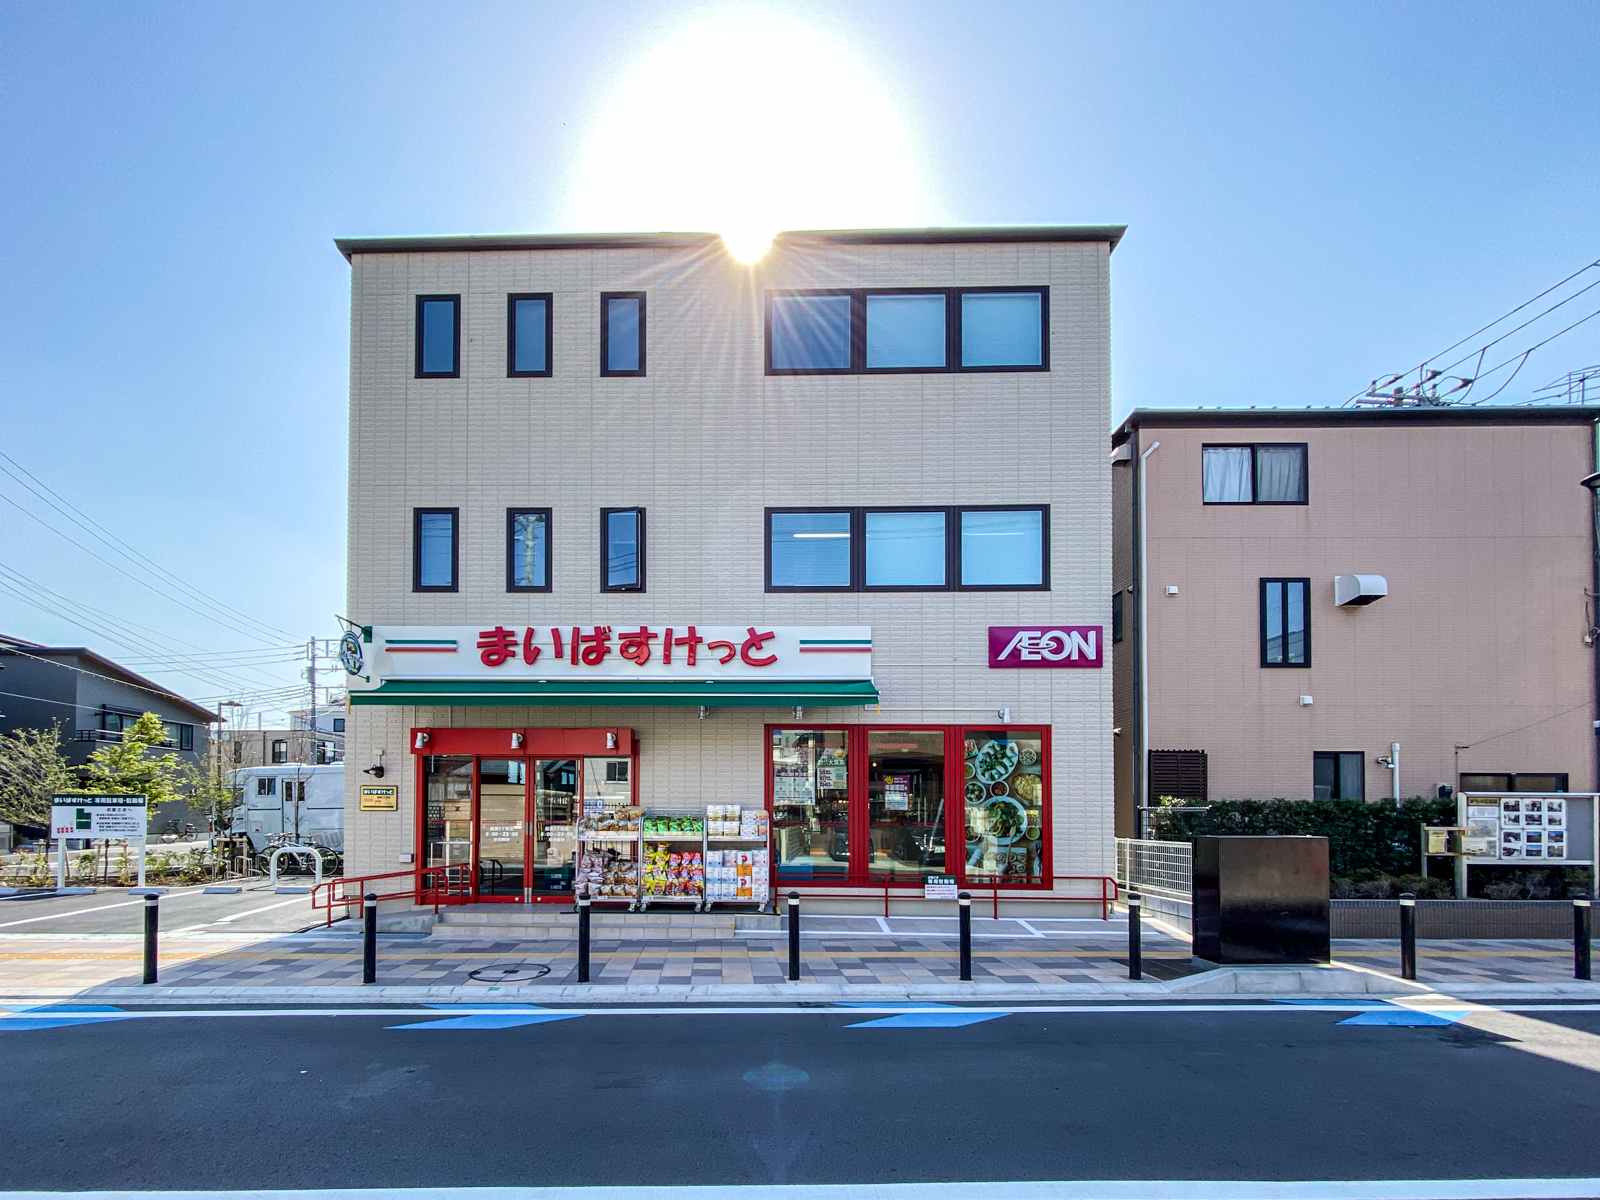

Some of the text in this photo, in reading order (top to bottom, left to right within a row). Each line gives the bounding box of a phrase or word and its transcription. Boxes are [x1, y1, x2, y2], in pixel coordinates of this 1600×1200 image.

[476, 625, 778, 667] まいばすけっと
